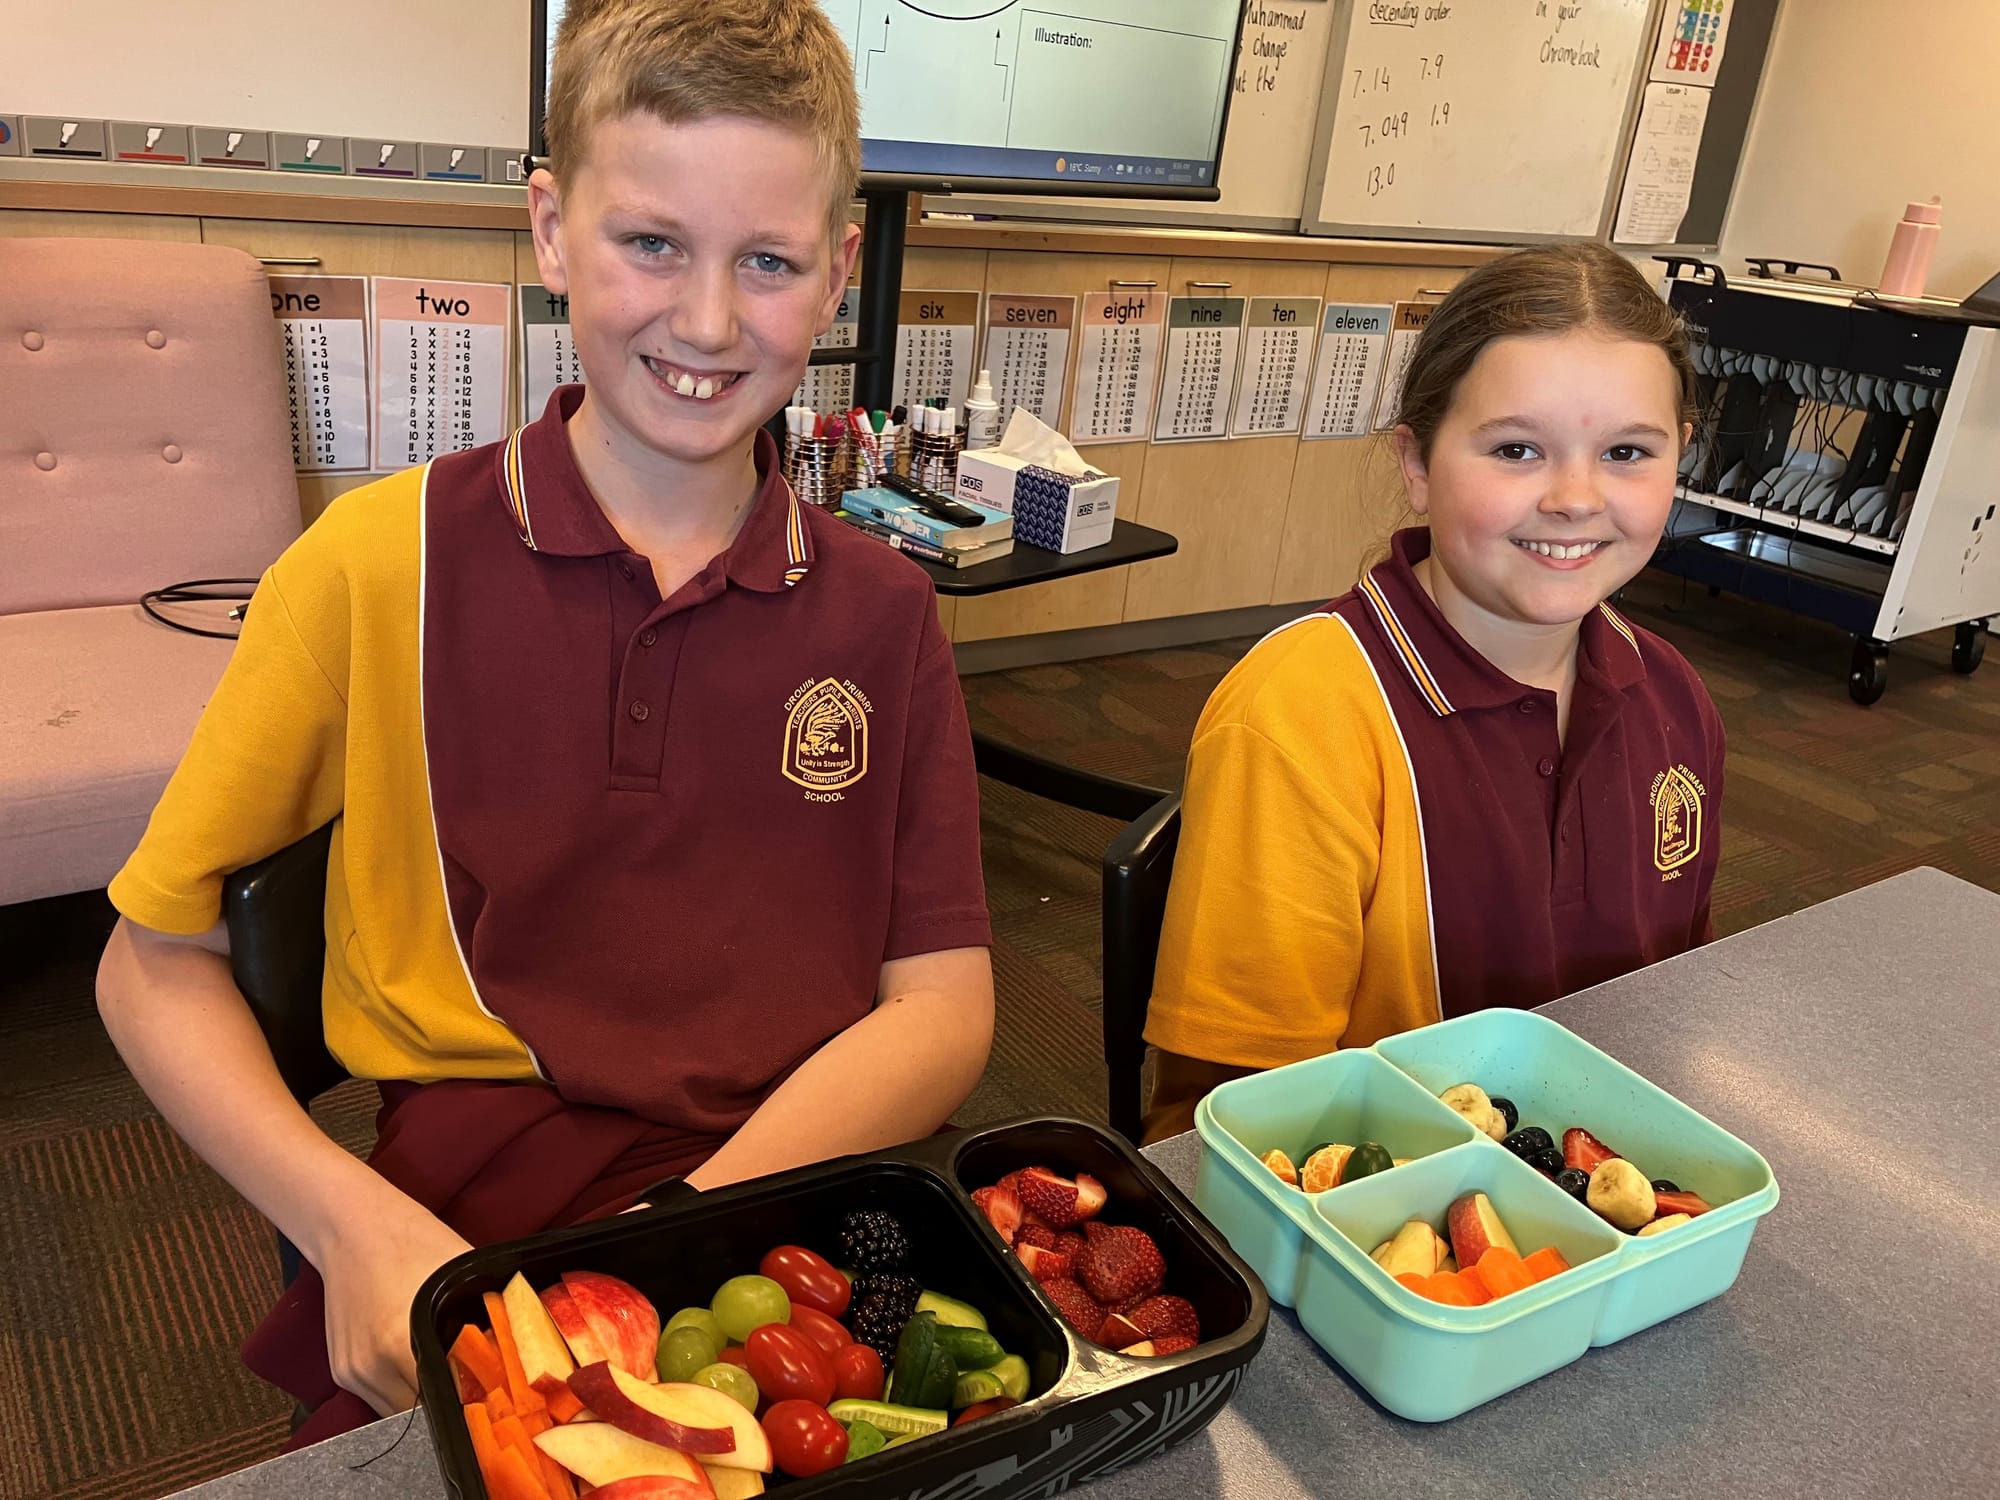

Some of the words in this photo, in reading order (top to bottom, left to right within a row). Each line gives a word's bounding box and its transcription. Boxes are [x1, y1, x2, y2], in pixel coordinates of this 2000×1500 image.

[1035, 27, 1092, 48] Illustration:
[1420, 54, 1443, 80] 7.9
[1257, 64, 1275, 92] the
[1359, 112, 1408, 147] 7.049
[1431, 102, 1450, 126] 1.9
[1367, 162, 1394, 196] 13.0
[415, 287, 470, 316] two
[920, 300, 945, 319] six
[1006, 307, 1057, 323] seven
[1103, 297, 1145, 324] eight
[1190, 306, 1222, 322] nine
[1272, 303, 1296, 322] ten
[1335, 309, 1379, 330] eleven
[1404, 307, 1433, 325] twe
[464, 329, 470, 338] 2
[320, 336, 327, 346] 2
[410, 338, 417, 348] 2
[464, 341, 470, 350] 4
[556, 341, 562, 350] 2
[321, 349, 328, 358] 3
[411, 350, 417, 359] 3
[464, 353, 470, 362] 6
[556, 352, 562, 361] 3
[322, 360, 328, 370] 4
[410, 362, 417, 371] 4
[463, 364, 470, 373] 8
[556, 364, 562, 372] 4
[322, 373, 329, 382] 5
[410, 374, 416, 383] 5
[463, 376, 472, 385] 10
[556, 375, 562, 383] 5
[323, 385, 330, 394] 6
[410, 386, 417, 394] 6
[463, 387, 471, 396] 12
[323, 397, 330, 406] 7
[410, 397, 416, 406] 7
[462, 398, 471, 407] 14
[324, 409, 331, 418] 8
[410, 409, 416, 418] 8
[462, 410, 471, 418] 16
[325, 420, 332, 429] 9
[410, 420, 417, 429] 9
[462, 421, 470, 430] 18
[325, 432, 335, 441] 10
[409, 432, 418, 440] 10
[461, 432, 474, 441] 20
[326, 455, 335, 464] 12
[409, 454, 417, 462] 12
[961, 475, 983, 491] COS
[1077, 503, 1093, 517] COS
[783, 677, 816, 712] DROUIN
[842, 679, 875, 714] PRIMARY
[791, 693, 818, 729] TEACHERS
[820, 685, 842, 699] PUPILS
[802, 773, 848, 784] COMMUNITY
[1649, 770, 1666, 806] DROUIN
[1677, 764, 1707, 797] PRIMARY
[804, 790, 846, 803] SCHOOL
